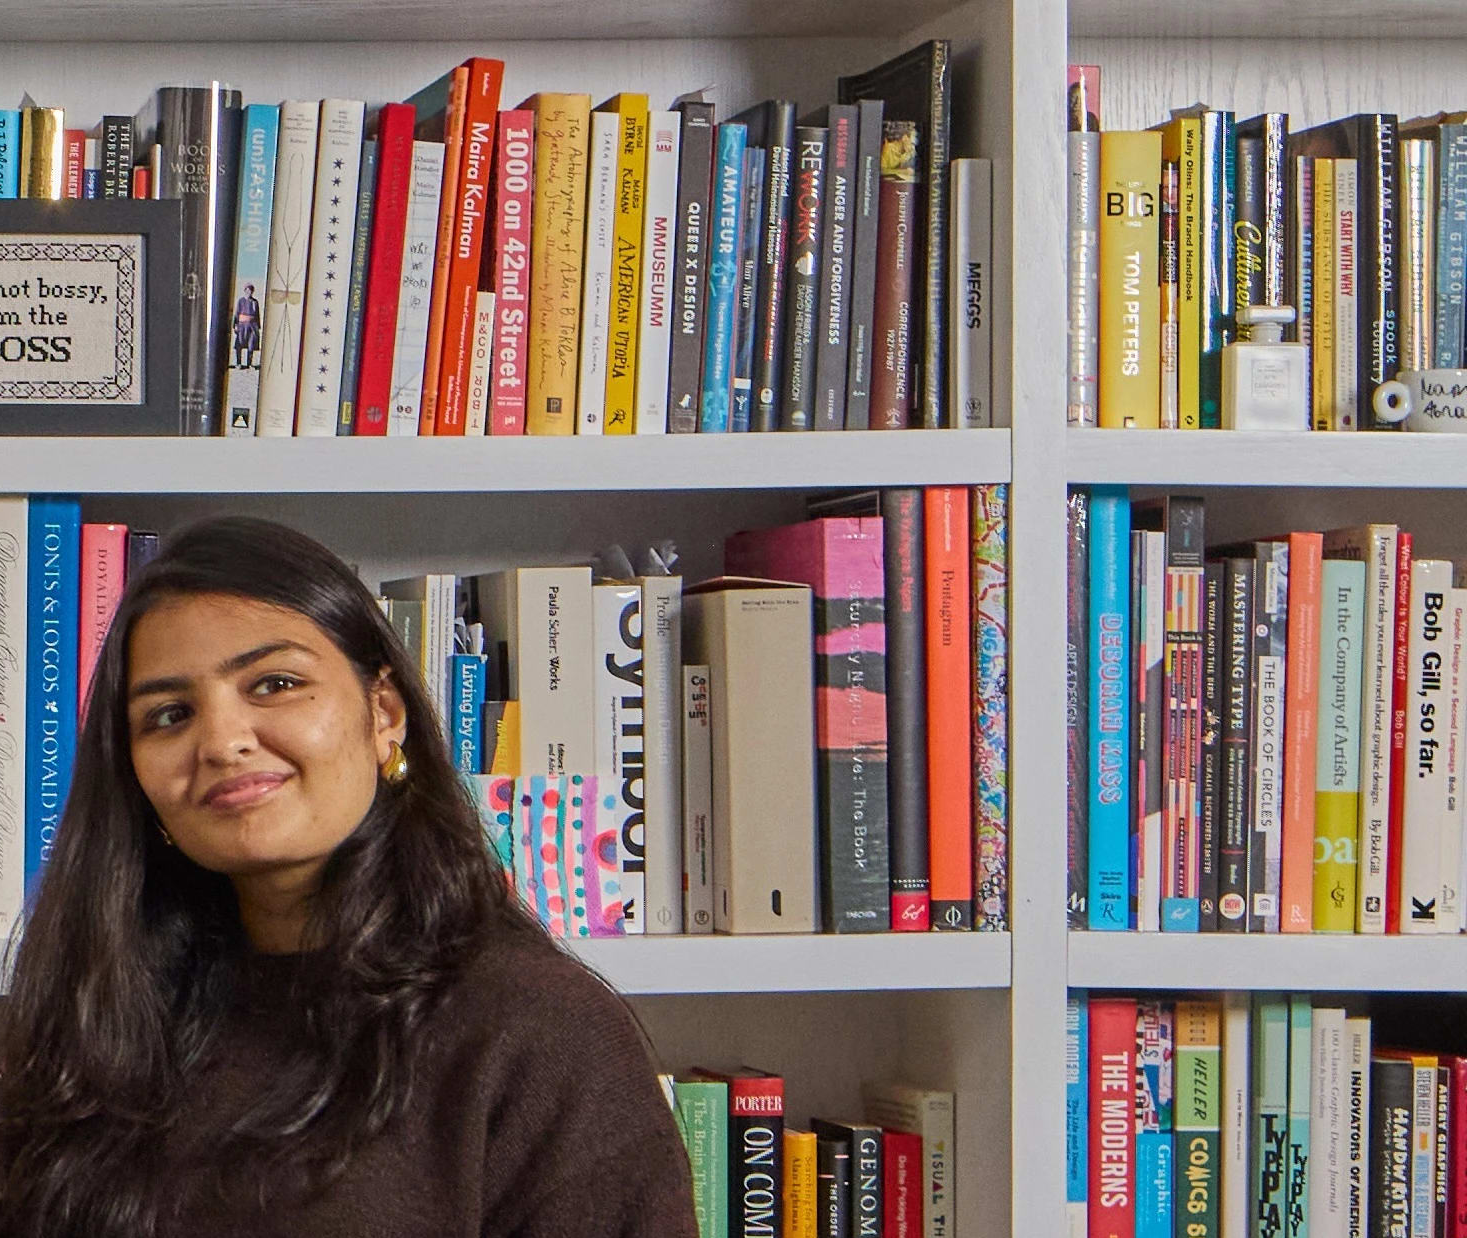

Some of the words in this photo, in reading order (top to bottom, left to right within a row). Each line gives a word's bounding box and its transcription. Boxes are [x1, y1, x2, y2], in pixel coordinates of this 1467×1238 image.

[467, 122, 489, 180] Maira
[505, 128, 528, 193] 1000
[459, 183, 483, 258] Kalman
[504, 199, 521, 230] on
[719, 166, 738, 254] AMATEUR
[4, 278, 31, 298] not
[38, 278, 108, 304] bossy,
[502, 237, 526, 300] 42nd
[1123, 251, 1140, 297] TOM
[28, 306, 67, 325] the
[968, 261, 982, 330] MEGGS
[499, 308, 524, 388] Street
[1121, 301, 1139, 377] PETERS
[549, 585, 560, 616] Paula
[940, 569, 955, 647] Pentagram
[1423, 591, 1444, 641] Bob
[549, 619, 560, 656] Scher:
[548, 658, 559, 691] Works
[1417, 651, 1442, 697] Gill,
[1420, 704, 1437, 733] so
[1418, 736, 1435, 779] far.
[1101, 1052, 1128, 1092] THE
[743, 1127, 774, 1167] ON
[1101, 1099, 1128, 1208] MODERNS
[1186, 1137, 1209, 1216] COMICS
